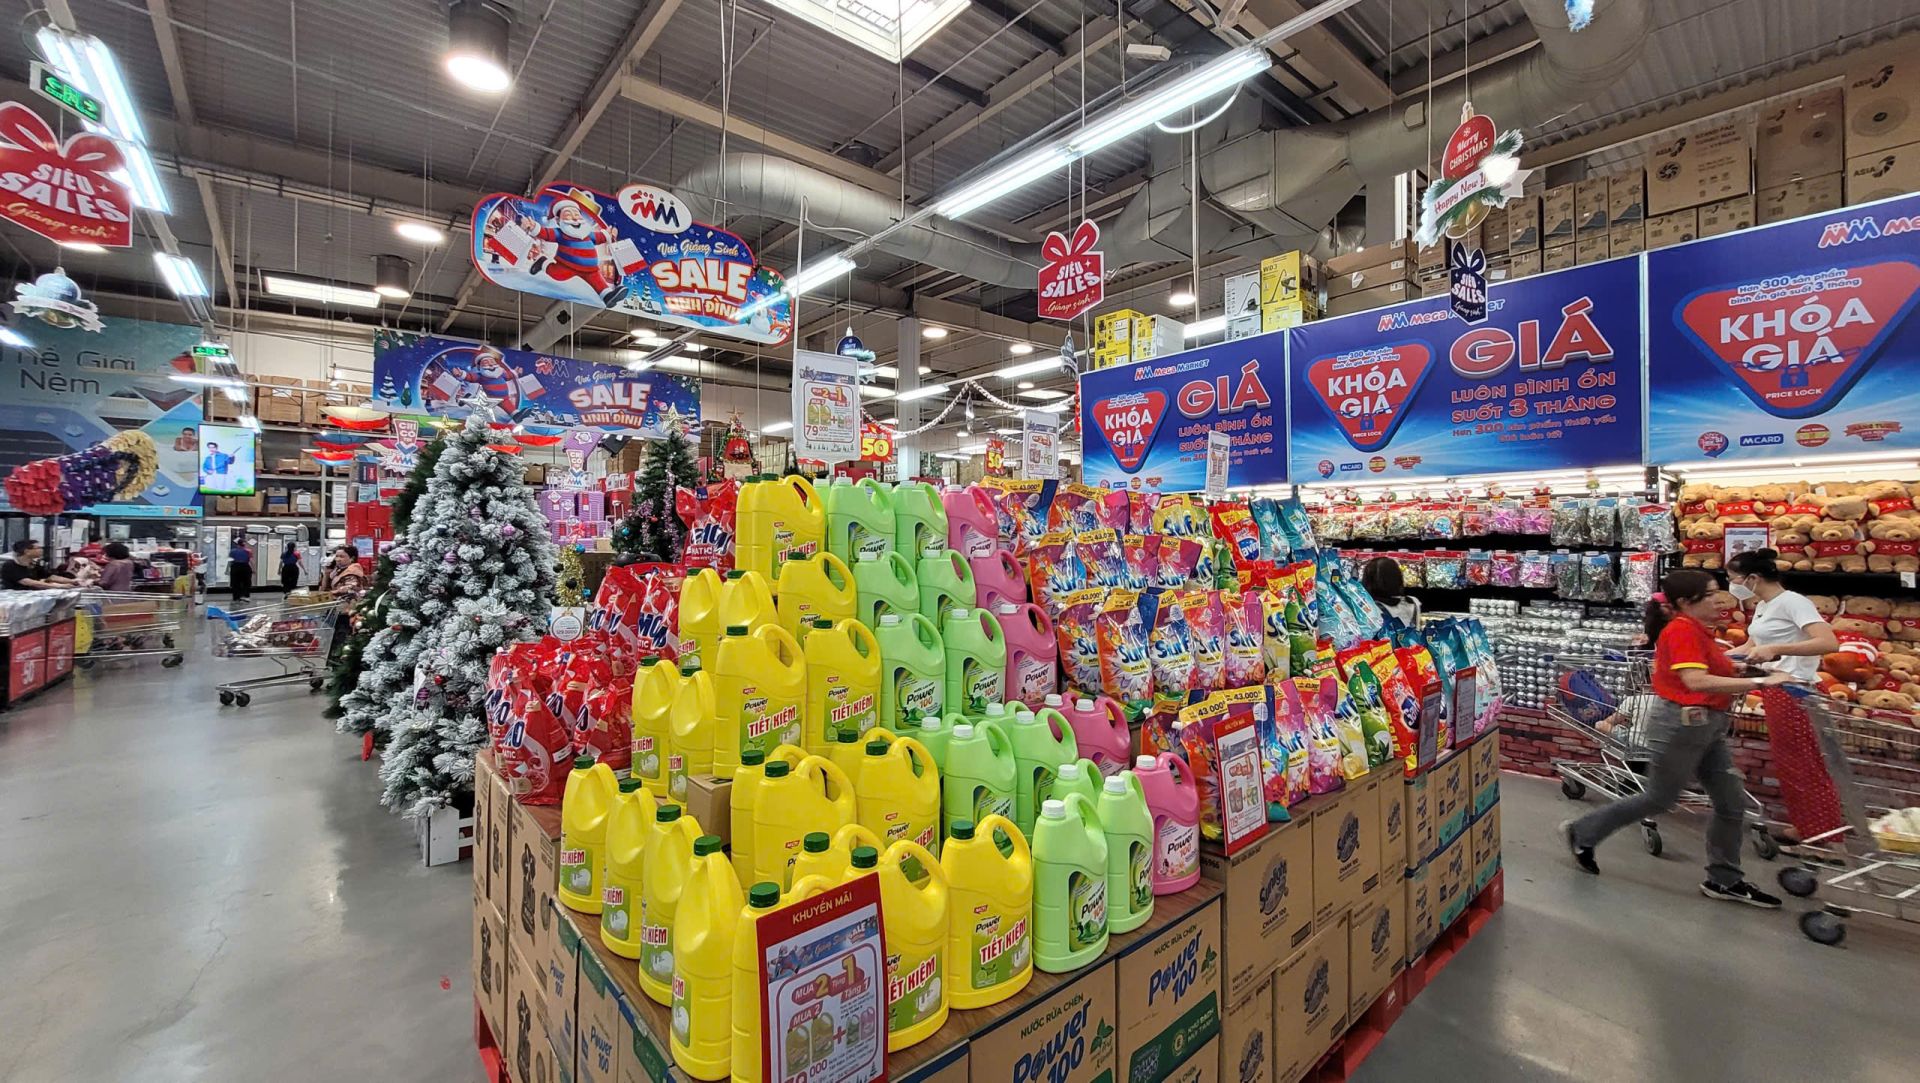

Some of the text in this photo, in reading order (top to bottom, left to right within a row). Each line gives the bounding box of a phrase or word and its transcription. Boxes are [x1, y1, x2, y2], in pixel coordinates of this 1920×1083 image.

[1449, 138, 1488, 170] CHRISTMAS
[1457, 131, 1480, 153] Merry
[30, 163, 95, 195] SIÊU
[0, 172, 129, 223] SALES
[1434, 193, 1459, 214] Happy
[1460, 180, 1480, 195] New
[657, 242, 677, 257] Vui
[713, 242, 739, 256] Sinh
[650, 257, 752, 301] SALE
[1057, 261, 1084, 280] SIÊU
[1041, 271, 1101, 298] SALES
[1451, 283, 1485, 303] SALES
[1739, 284, 1759, 293] Hơn
[1761, 277, 1789, 289] 300
[1814, 281, 1824, 292] 3
[1720, 295, 1876, 344] KHÓA
[1450, 296, 1614, 375] GIÁ
[1741, 326, 1846, 373] GIÁ
[21, 368, 100, 396] Nệm
[1178, 358, 1271, 417] GIÁ
[1328, 365, 1407, 397] KHÓA
[1451, 385, 1507, 403] LUÔN
[1514, 378, 1570, 397] BÌNH
[1765, 387, 1823, 399] PRICE LOCK
[568, 382, 651, 412] SALE
[1340, 388, 1392, 419] GIÁ
[1452, 394, 1617, 423] SUỐT 3 THÁNG
[581, 410, 643, 428] LINH ĐÌNH
[1104, 406, 1153, 430] KHÓA
[1179, 423, 1211, 437] LUÔN
[1215, 419, 1247, 432] BÌNH
[1475, 422, 1504, 435] 300
[805, 425, 818, 436] 79
[1112, 426, 1145, 447] GIÁ
[861, 438, 889, 457] 50
[775, 532, 795, 540] Power
[973, 677, 999, 693] Power
[1025, 667, 1051, 684] Power
[1036, 676, 1048, 687] 100
[828, 686, 850, 698] Power
[907, 686, 936, 705] Power
[919, 696, 933, 709] 100
[984, 687, 997, 697] 100
[744, 699, 769, 711] Power
[831, 694, 874, 723] TIẾT KIỆM
[749, 705, 797, 738] TIẾT KIỆM
[887, 823, 912, 838] Power
[1167, 832, 1194, 855] Power
[792, 891, 852, 925] KHUYẾN MÃI
[976, 916, 1001, 933] Power
[980, 916, 1026, 964] TIẾT KIỆM
[794, 983, 815, 999] MUA
[815, 974, 829, 999] 2
[842, 954, 857, 985] 1
[907, 956, 936, 993] KIỆM
[1149, 929, 1203, 1007] Power
[1172, 958, 1197, 1005] 100
[793, 1011, 812, 1026] MUA
[1020, 1019, 1045, 1040] NƯỚC
[1063, 992, 1084, 1013] CHÉN
[590, 1024, 614, 1057] Power
[1013, 998, 1093, 1083] Power
[809, 1059, 828, 1078] 000
[1046, 1035, 1085, 1083] 100
